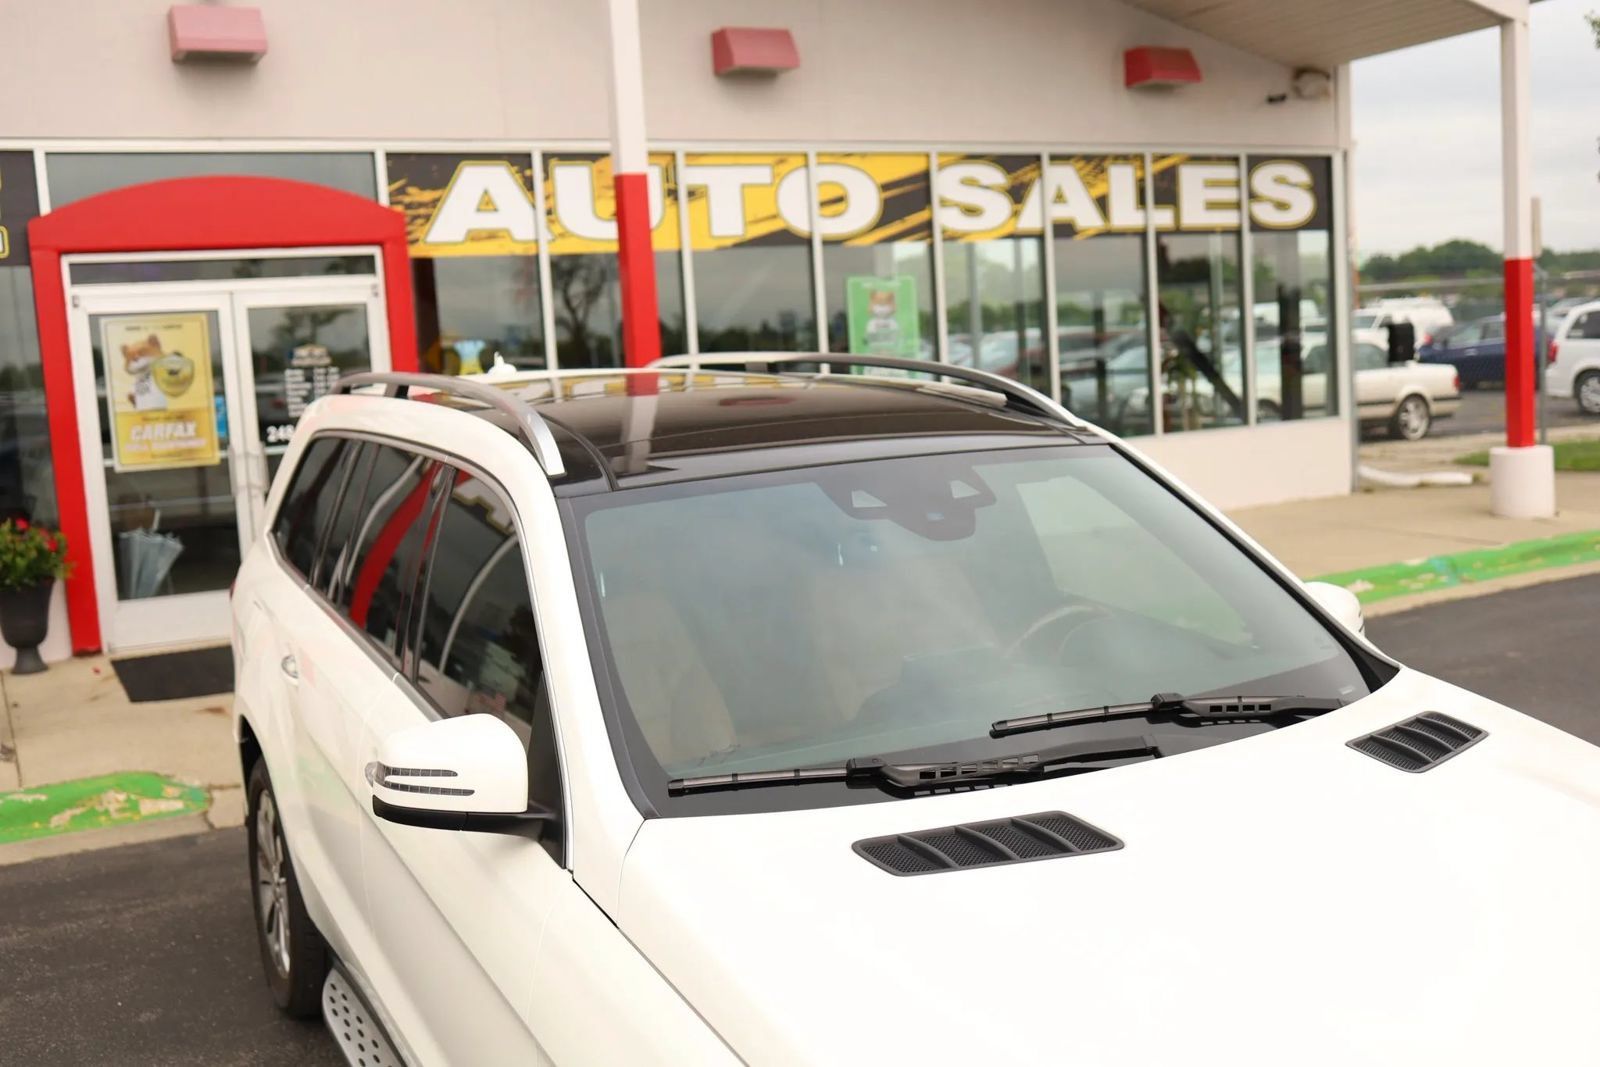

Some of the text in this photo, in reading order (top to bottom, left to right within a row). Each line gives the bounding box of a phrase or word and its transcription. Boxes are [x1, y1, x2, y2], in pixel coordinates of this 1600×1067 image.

[423, 160, 1316, 244] AUTO SALES
[131, 420, 197, 441] CARFAX
